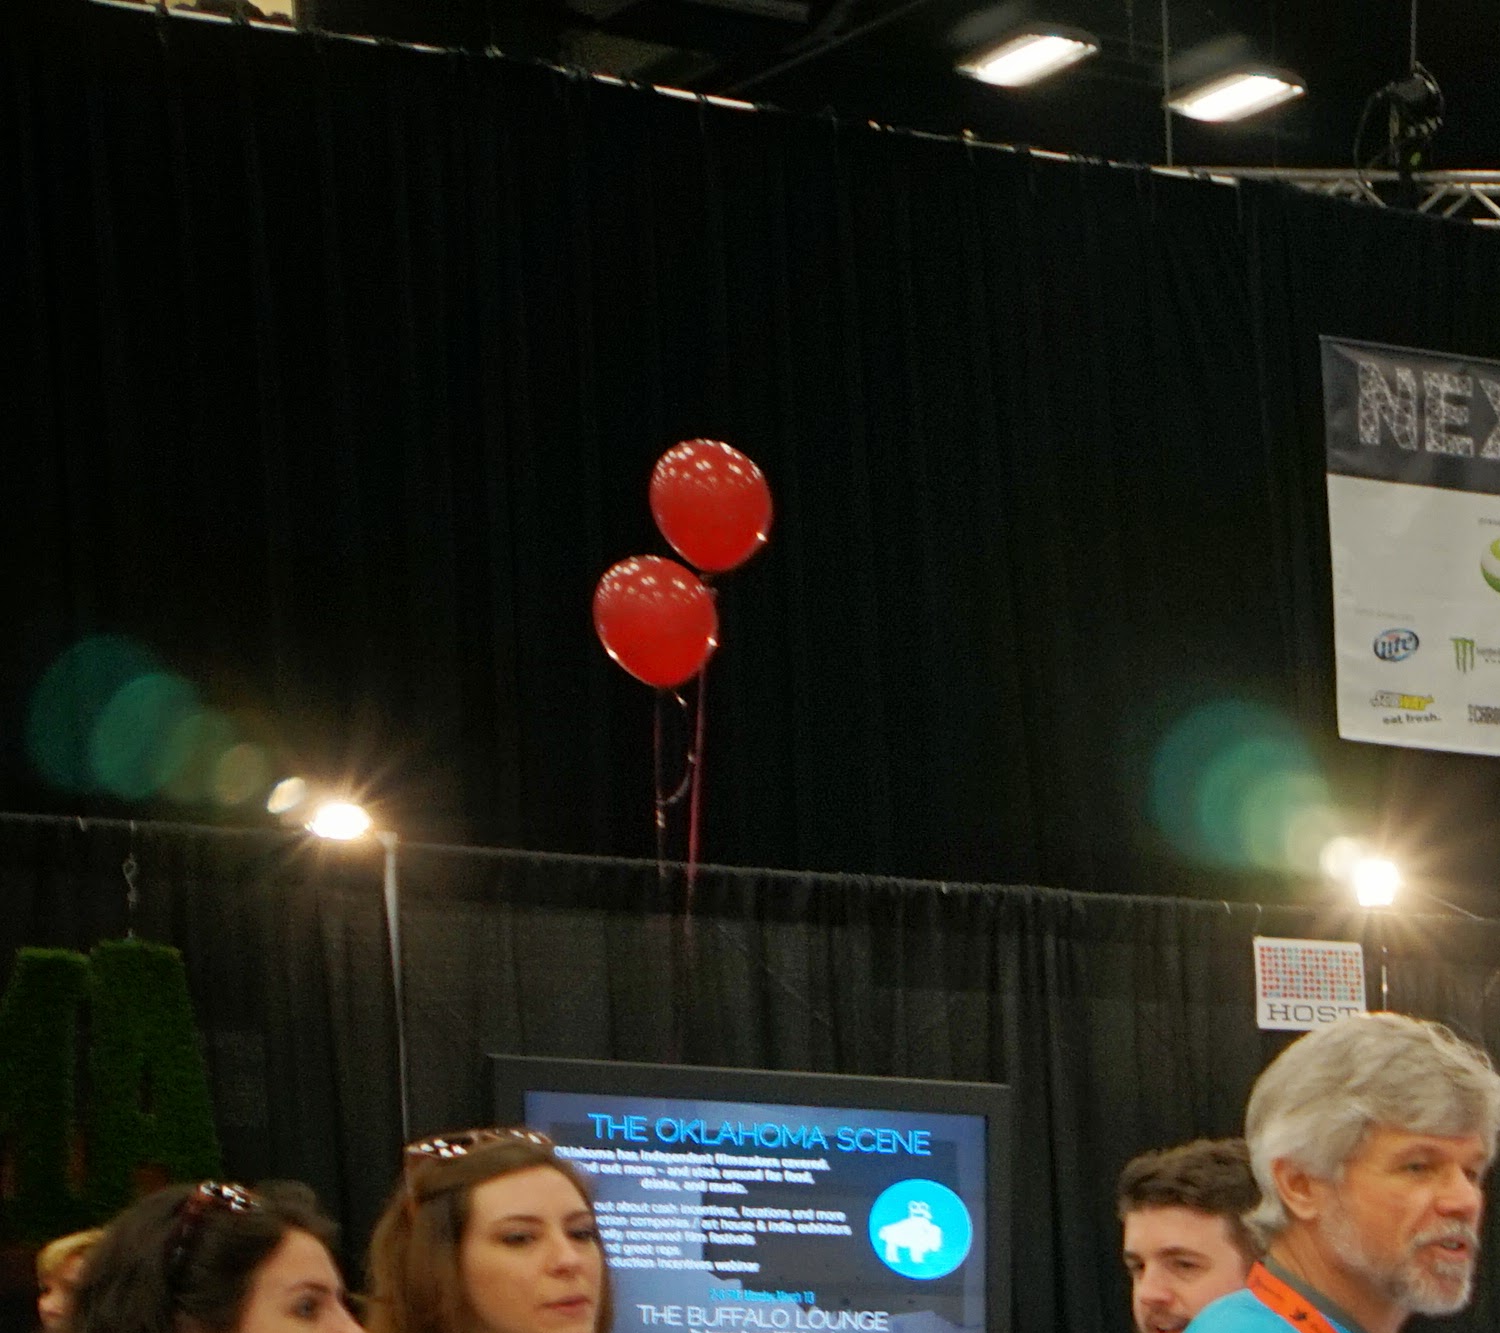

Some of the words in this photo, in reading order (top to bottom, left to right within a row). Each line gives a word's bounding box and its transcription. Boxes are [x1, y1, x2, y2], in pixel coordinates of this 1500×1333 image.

[587, 1113, 649, 1143] THE
[655, 1117, 830, 1151] OKLAHOMA
[836, 1126, 932, 1157] SCENE
[636, 1304, 684, 1327] THE
[687, 1306, 790, 1330] BUFFALO
[796, 1310, 889, 1332] LOUNGE
